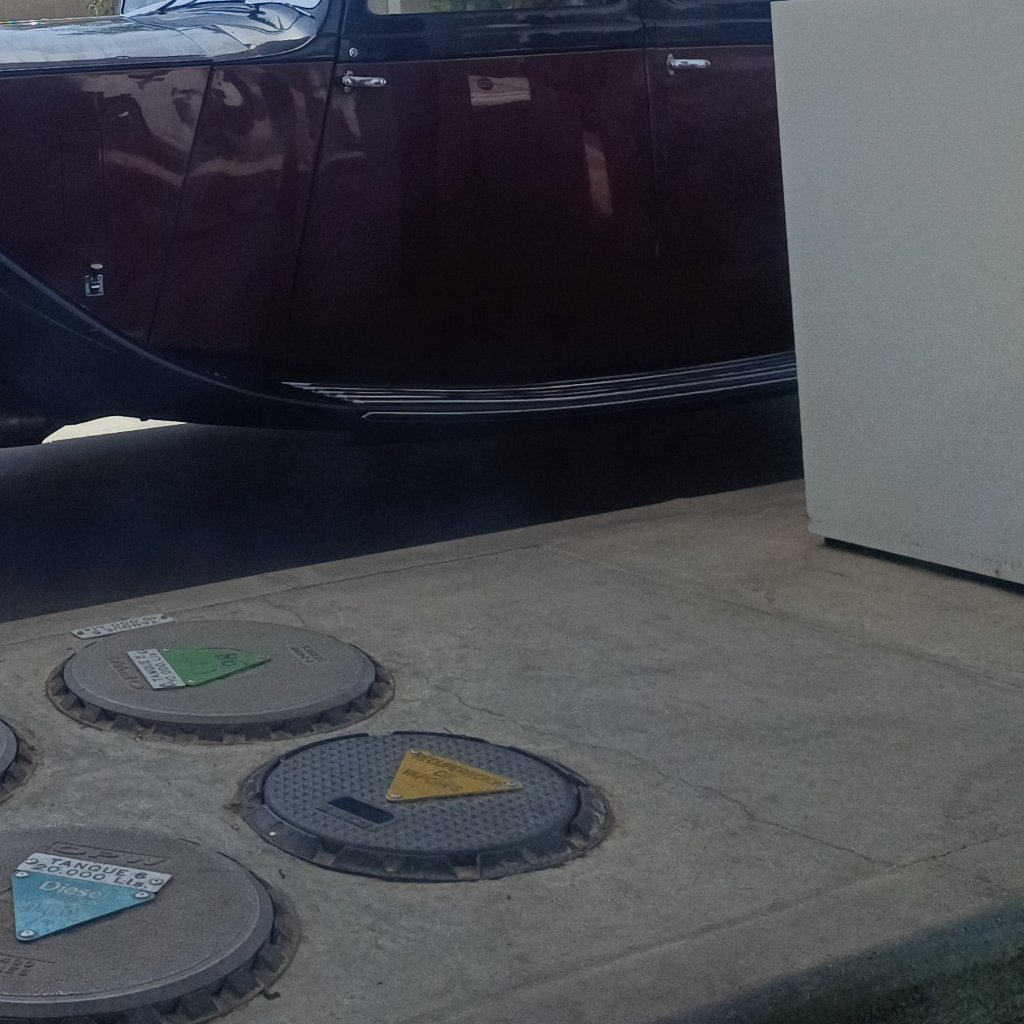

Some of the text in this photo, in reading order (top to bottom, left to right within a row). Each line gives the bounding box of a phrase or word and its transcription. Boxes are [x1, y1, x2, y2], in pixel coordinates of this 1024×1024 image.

[34, 863, 106, 881] 20.000
[51, 857, 149, 880] TANQUE 6
